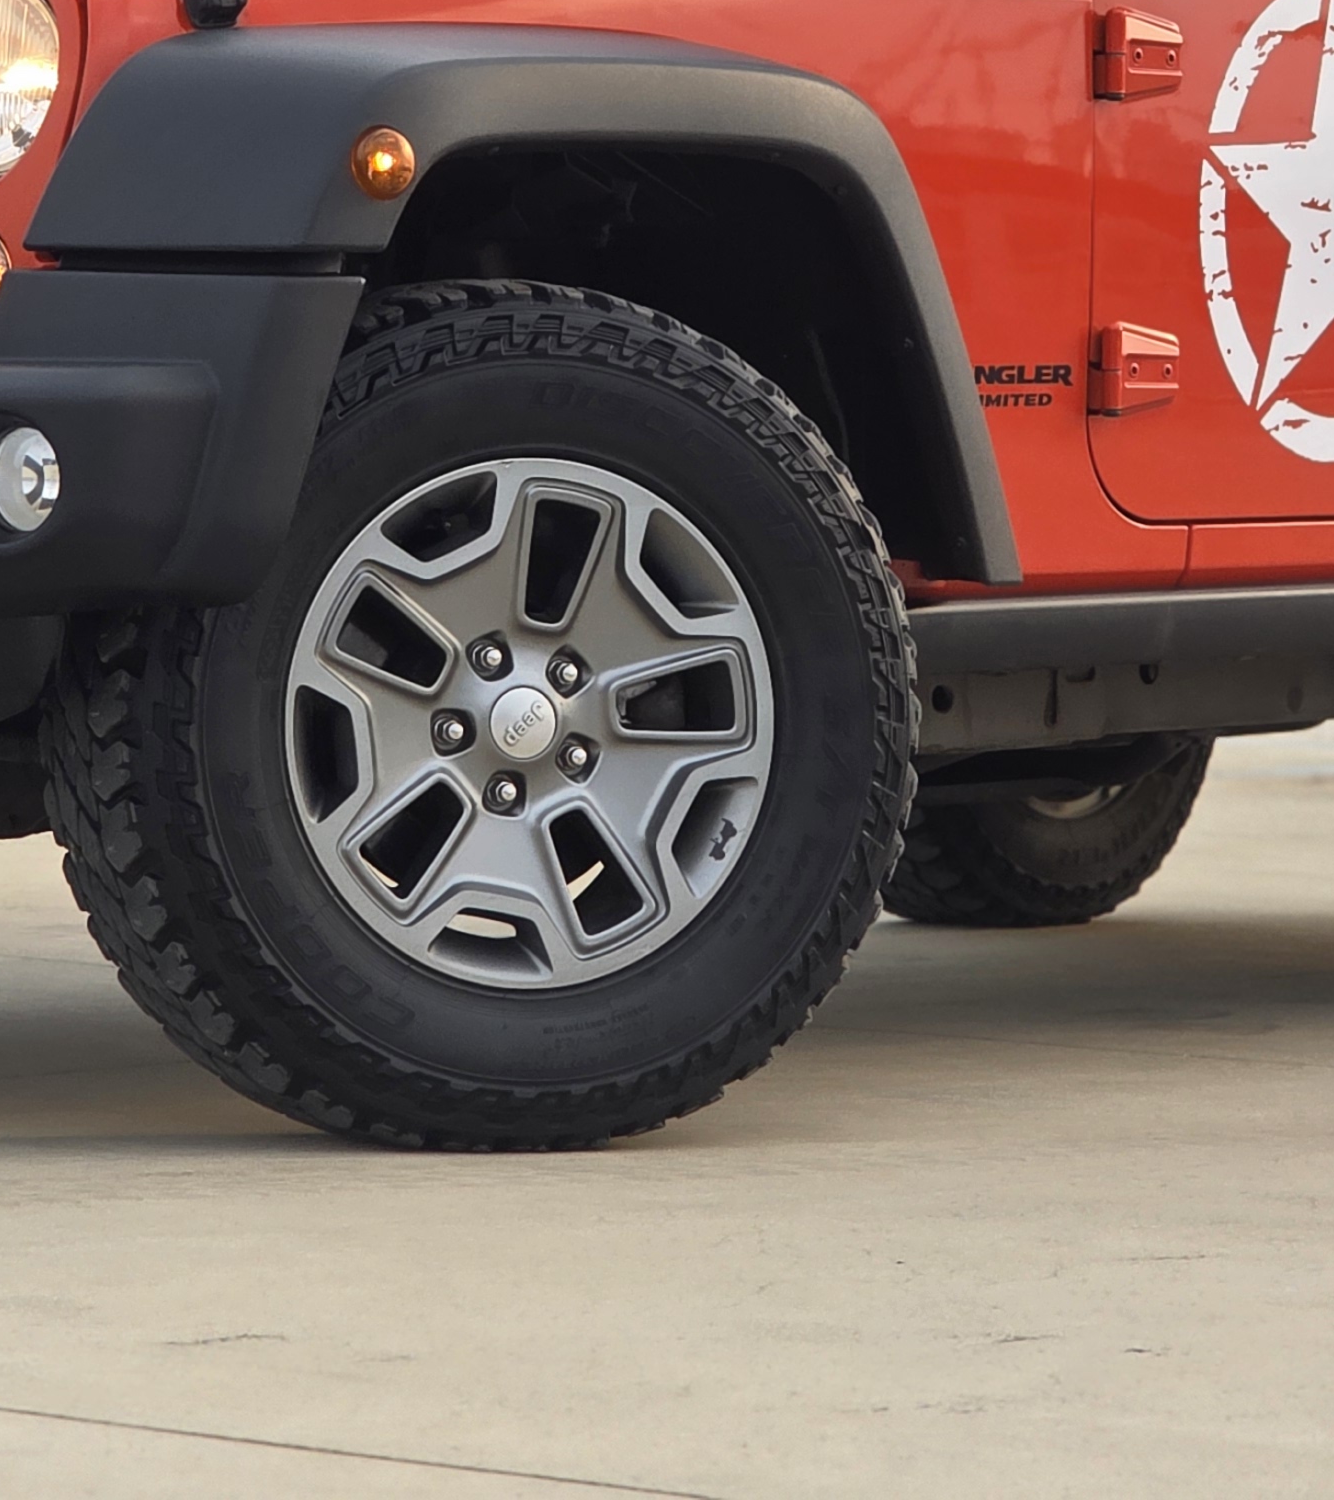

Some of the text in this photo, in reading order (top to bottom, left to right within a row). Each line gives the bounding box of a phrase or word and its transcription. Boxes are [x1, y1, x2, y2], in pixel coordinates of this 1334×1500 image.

[974, 364, 1073, 387] NGLER
[979, 393, 1053, 407] IMITED
[503, 700, 545, 747] Jeep
